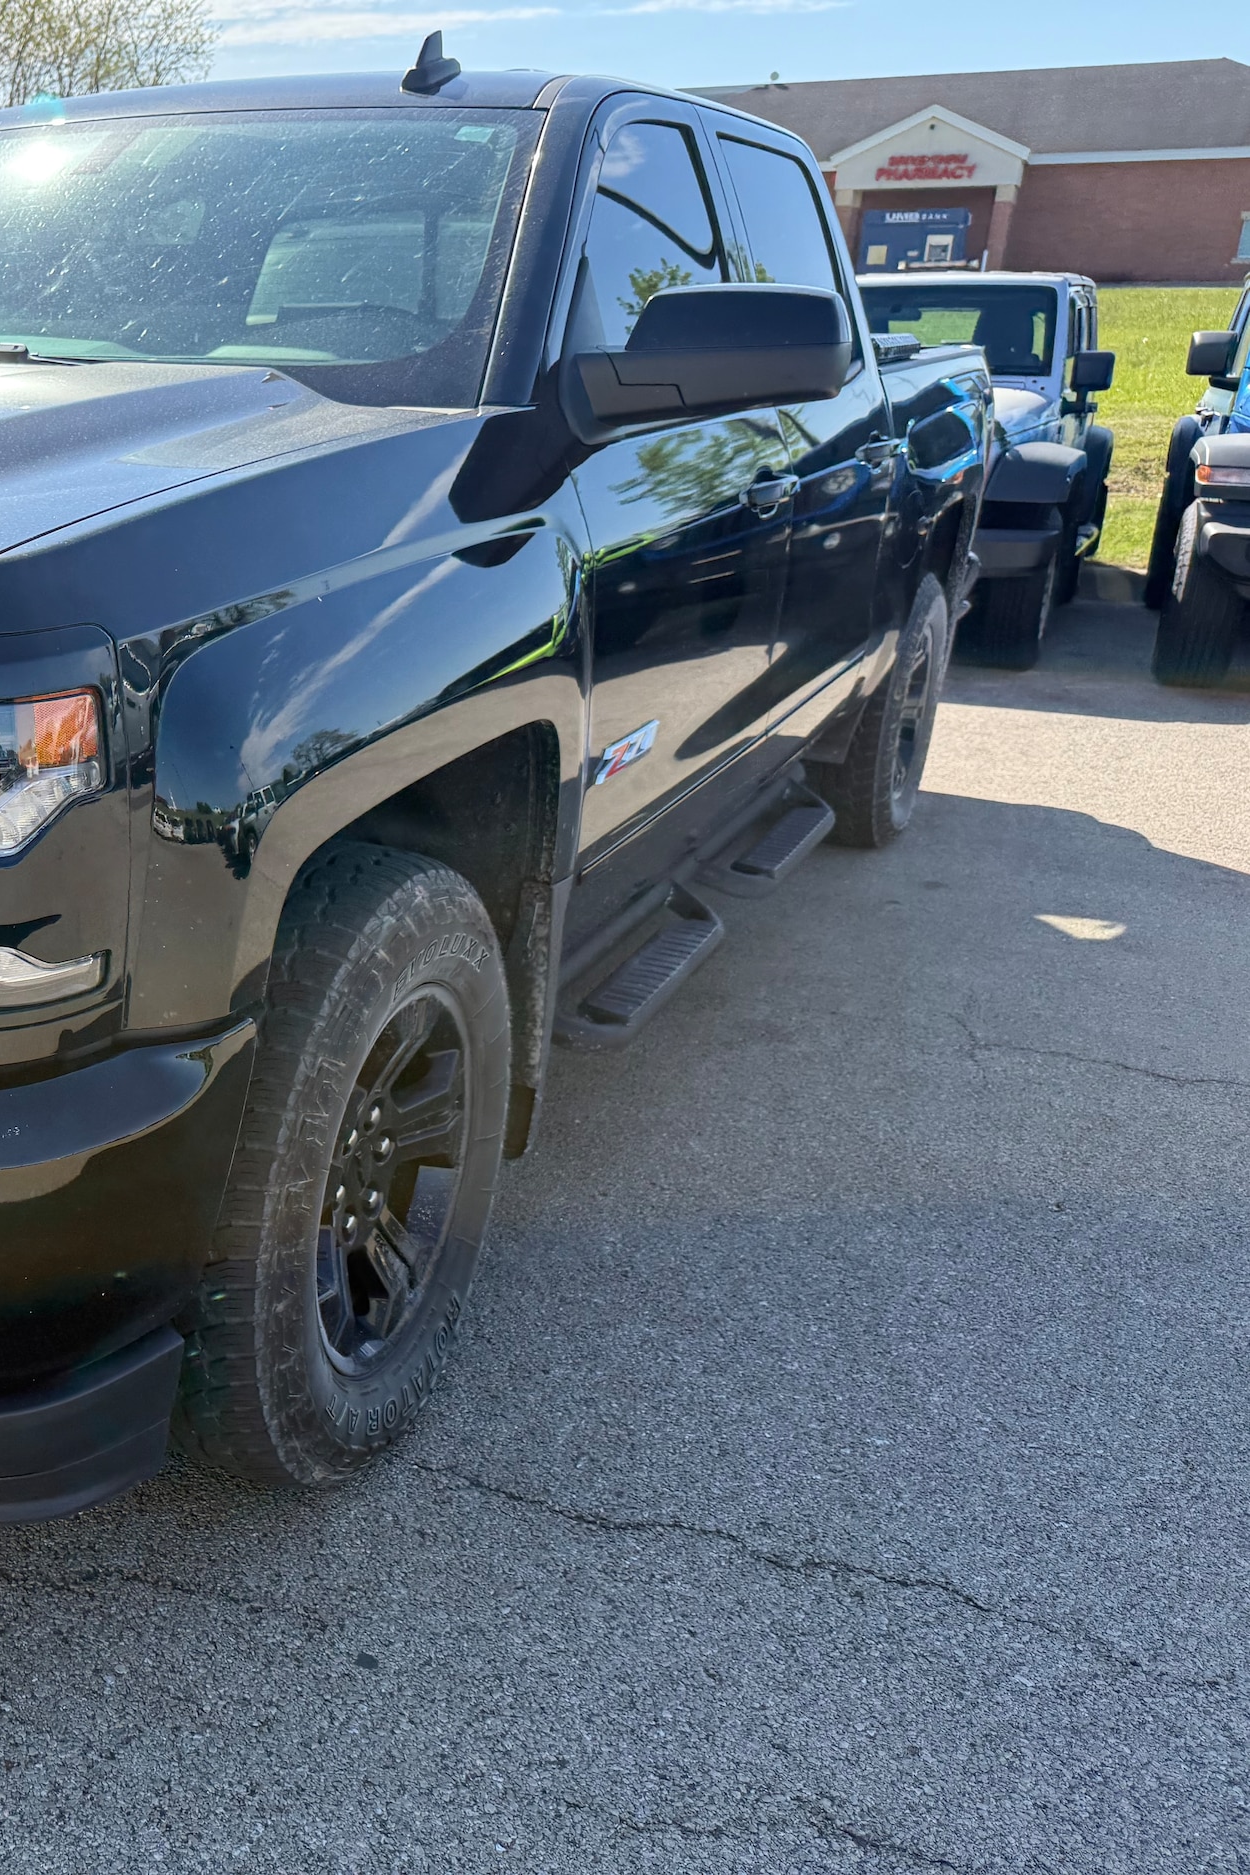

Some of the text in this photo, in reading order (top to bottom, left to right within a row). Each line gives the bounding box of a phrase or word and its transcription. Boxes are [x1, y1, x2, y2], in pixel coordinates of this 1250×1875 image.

[392, 932, 490, 1003] EVOLUXX
[325, 1295, 461, 1436] ROTATOR A/T
